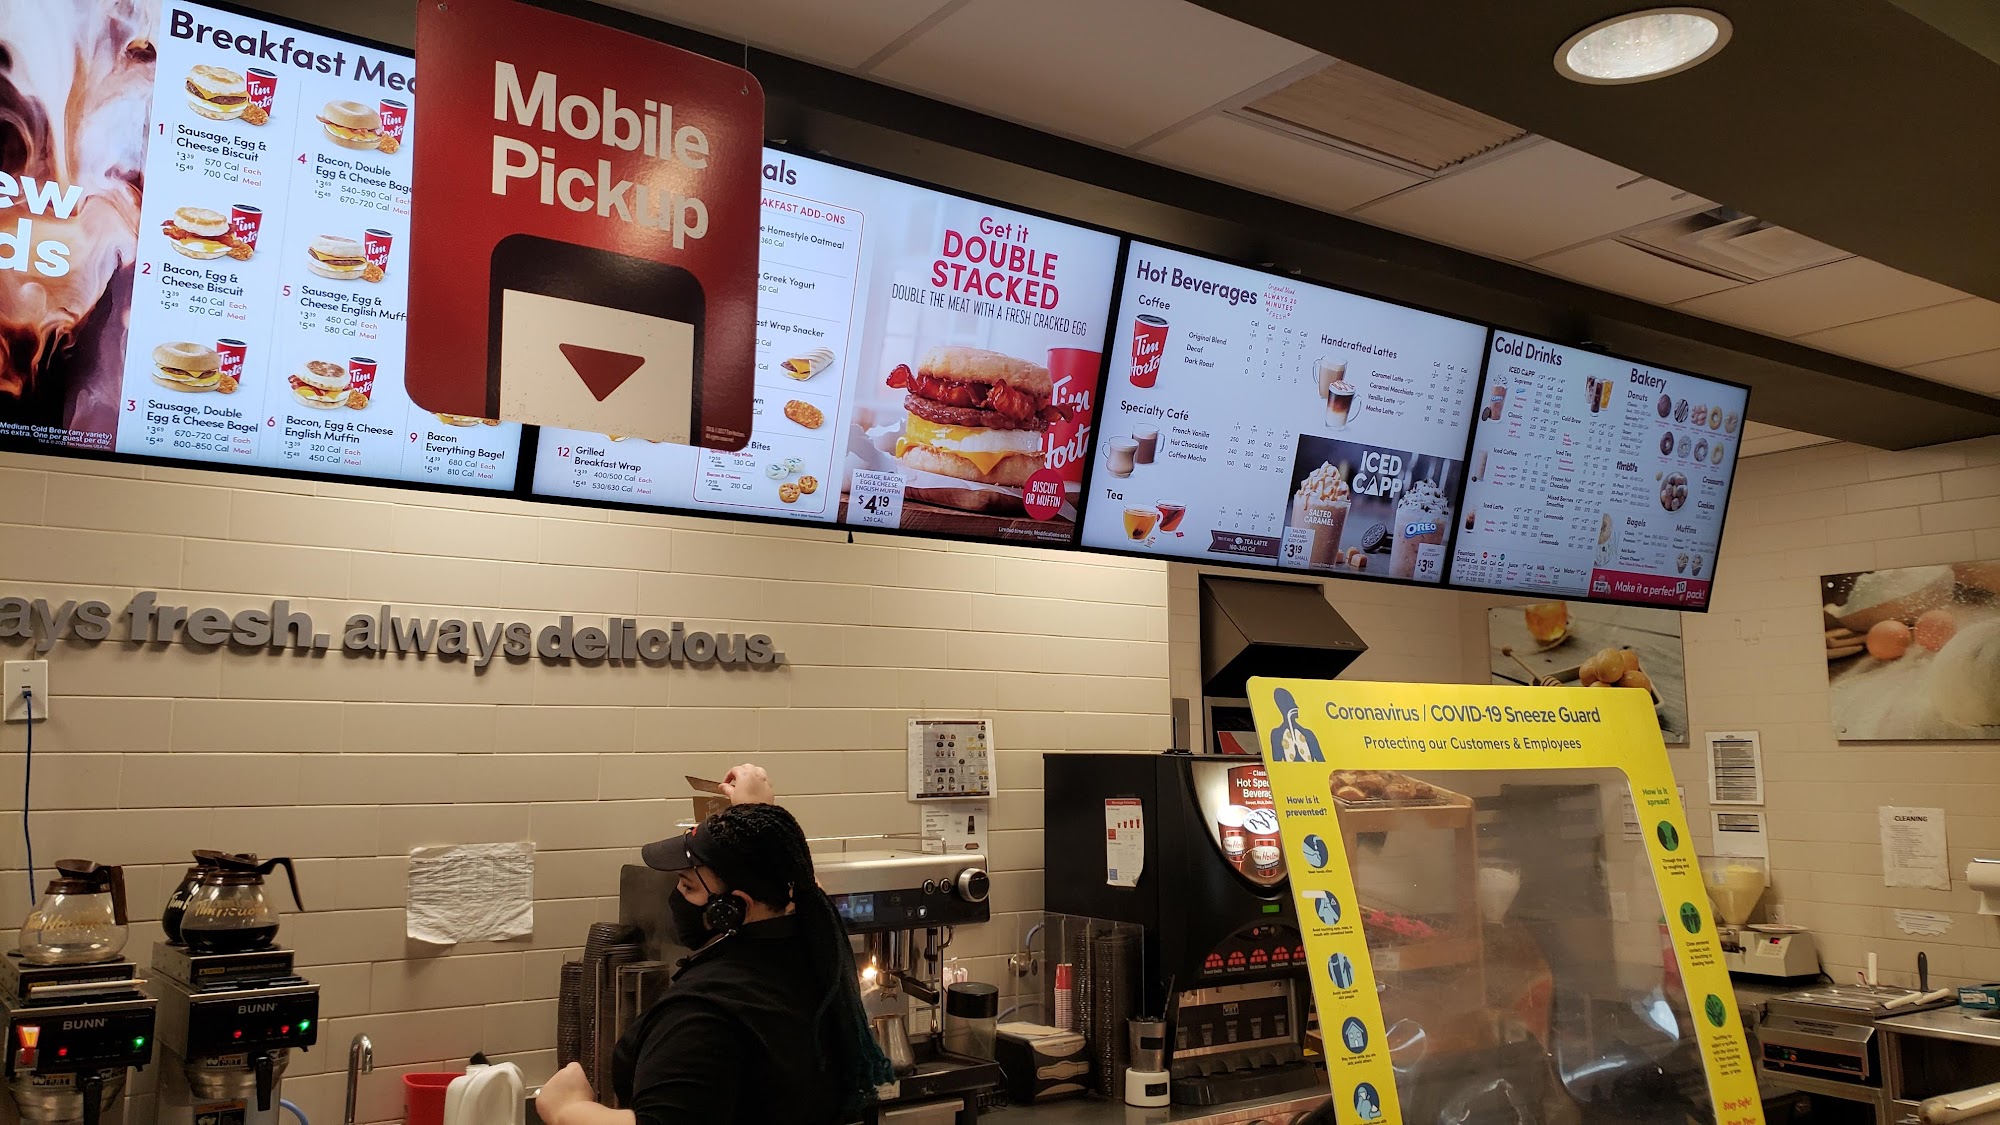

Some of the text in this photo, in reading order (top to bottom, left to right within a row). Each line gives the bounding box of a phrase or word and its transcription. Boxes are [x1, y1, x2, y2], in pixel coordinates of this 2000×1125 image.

[170, 8, 346, 78] Breakfast
[494, 60, 709, 169] Mobile
[158, 124, 164, 134] 1
[177, 124, 266, 151] Sausage, Egg &
[176, 137, 259, 162] Cheese Biscuit
[205, 158, 262, 176] 570 Cal Each
[297, 154, 307, 164] 4
[317, 154, 391, 177] Bacon, Double
[203, 169, 262, 187] 700 Cal Meal
[316, 166, 386, 188] Egg & Cheese
[492, 135, 708, 249] Pickup
[800, 207, 846, 225] ADD-ONS
[768, 225, 844, 249] Homestyle Oatmeal
[980, 217, 1029, 243] Get it
[943, 229, 1058, 280] DOUBLE
[142, 263, 151, 274] 2
[163, 263, 238, 284] Bacon, Egg &
[162, 276, 244, 296] Cheese Biscuit
[763, 273, 815, 289] Greek Yogurt
[932, 260, 1059, 310] STACKED
[1137, 260, 1258, 306] Hot Beverages
[283, 285, 291, 296] 5
[302, 285, 382, 307] Sausage, Egg &
[1264, 293, 1288, 302] ALWAYS
[300, 298, 376, 319] Cheese English
[892, 284, 1087, 336] DOUBLE THE MEAT WITH A FRESH CRACKED EGG
[1138, 295, 1171, 310] Coffee
[1265, 301, 1293, 311] MINUTES
[770, 320, 825, 338] Wrap Snacker
[1135, 334, 1159, 356] Tim
[1187, 345, 1204, 353] Decaf
[1321, 334, 1397, 359] Handcrafted Lattes
[1495, 337, 1562, 366] Cold Drinks
[1185, 357, 1214, 368] Dark Roast
[1630, 368, 1667, 393] Bakery
[1628, 390, 1648, 401] Donuts
[127, 400, 135, 411] 3
[148, 400, 242, 419] Sausage, Double
[1121, 401, 1189, 421] Specialty Café
[147, 412, 258, 434] Egg & Cheese Bagel
[267, 416, 276, 427] 6
[286, 415, 393, 436] Bacon, Egg & Cheese
[0, 422, 29, 431] Medium
[49, 427, 67, 435] Brew
[69, 429, 84, 437] (any
[86, 432, 112, 440] variety)
[285, 428, 359, 444] English Muffin
[410, 432, 418, 443] 9
[427, 432, 457, 443] Bacon
[1172, 427, 1210, 438] French Vanilla
[426, 443, 504, 460] Everything Bagel
[557, 446, 570, 458] 12
[575, 446, 604, 457] Grilled
[751, 441, 771, 451] Bites
[1170, 439, 1208, 451] Hot Chocolate
[574, 457, 641, 472] Breakfast Wrap
[1361, 451, 1402, 476] ICED
[855, 473, 903, 484] SAUSAGE, BACON,
[1352, 474, 1403, 498] CAPP
[1032, 481, 1058, 494] BISCUIT
[1106, 489, 1123, 500] Tea
[1026, 492, 1060, 508] OR MUFFIN
[1304, 516, 1334, 526] CARAMEL
[1309, 509, 1331, 518] SALTED
[1406, 523, 1436, 535] OREO
[1615, 582, 1635, 593] Make
[1636, 584, 1642, 594] it
[1650, 585, 1675, 598] perfect
[1677, 582, 1685, 592] 10
[1687, 590, 1704, 601] pack!
[127, 591, 330, 648] fresh.
[344, 604, 532, 668] always
[537, 615, 785, 666] delicious.
[1325, 702, 1600, 724] Coronavirus / COVID-19 Sneeze Guard
[1364, 736, 1581, 753] Protecting our Customers & Employees
[1237, 778, 1251, 787] Hot
[1287, 797, 1302, 805] How
[1647, 797, 1670, 807] spread?
[1286, 807, 1327, 818] prevented?
[1894, 815, 1927, 823] CLEANING
[238, 1003, 275, 1015] BUNN
[63, 1018, 105, 1031] BUNN
